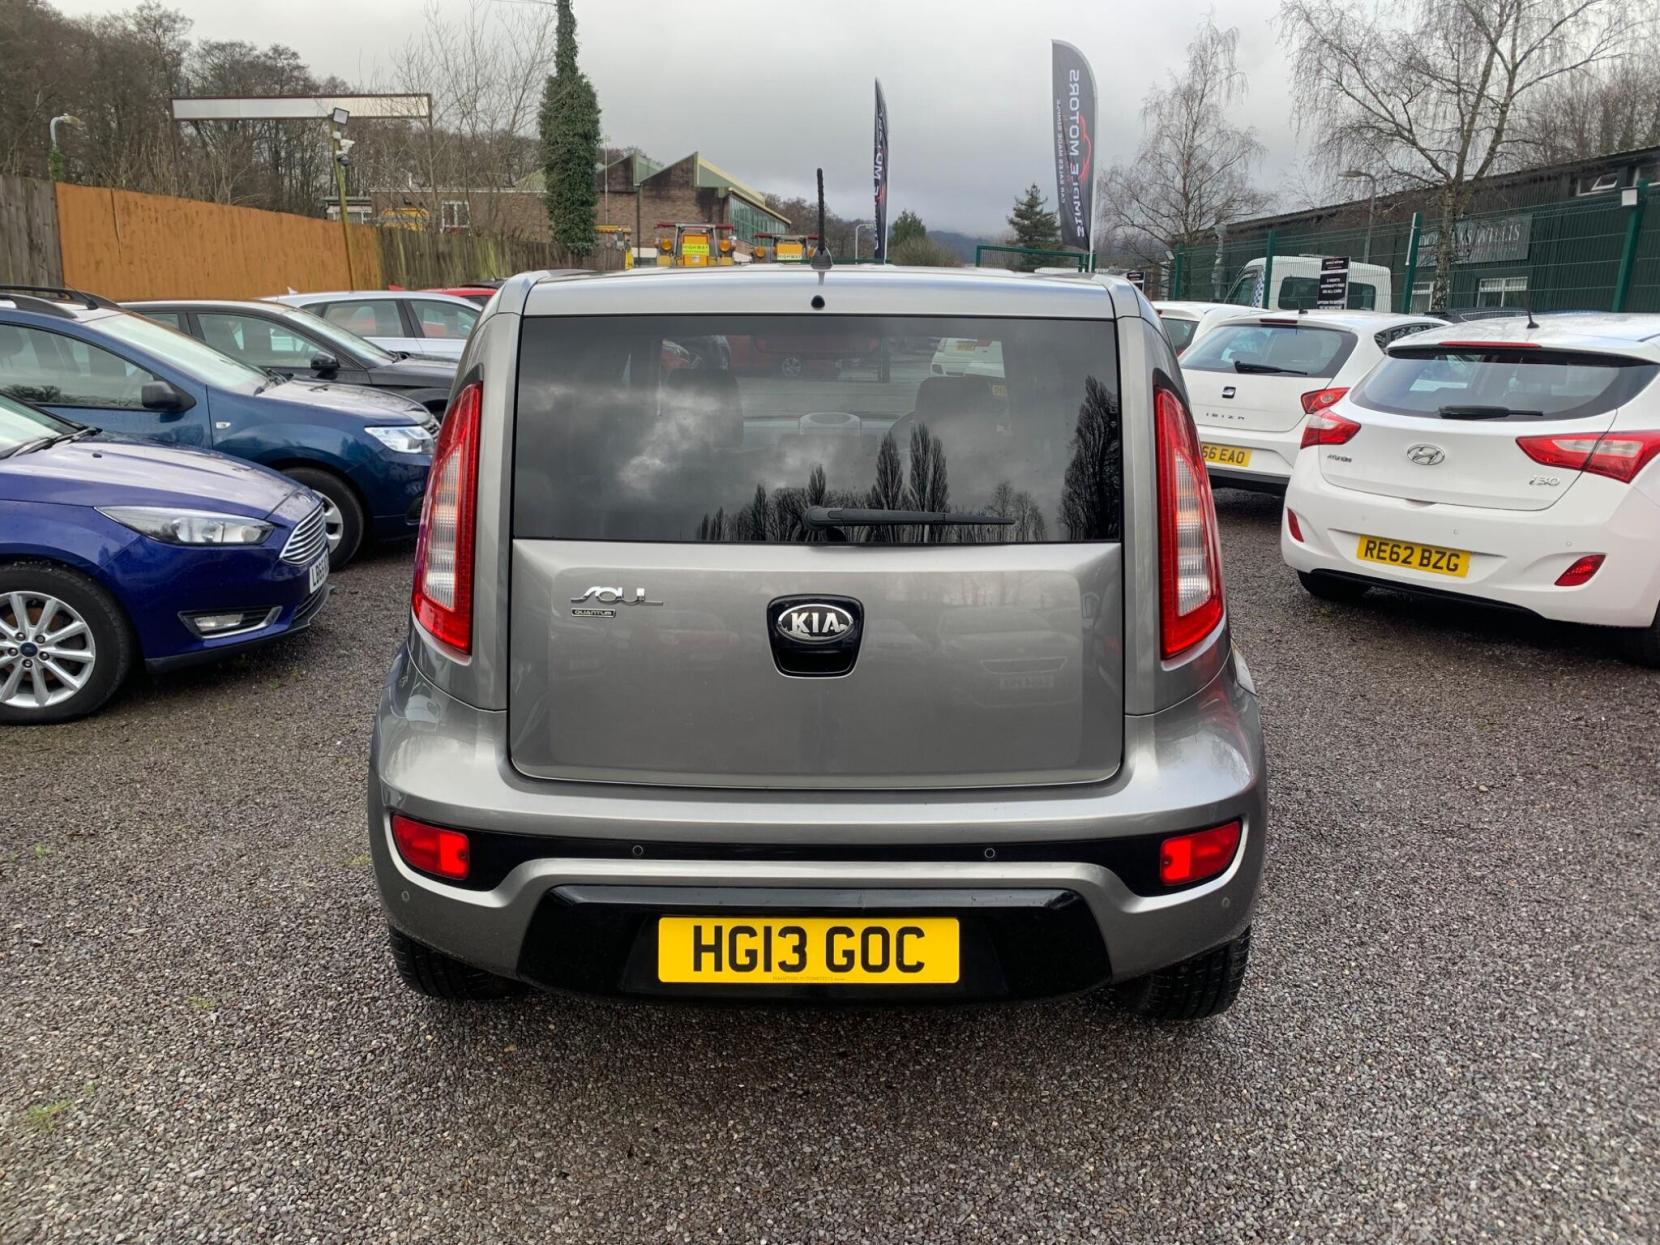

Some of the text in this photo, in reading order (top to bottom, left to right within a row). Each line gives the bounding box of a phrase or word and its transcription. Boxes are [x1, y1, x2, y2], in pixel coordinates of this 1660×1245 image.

[1219, 448, 1246, 465] EAO
[1364, 540, 1461, 573] RE62 BZG
[791, 612, 842, 634] KIA
[693, 925, 926, 973] HG13 GOC
